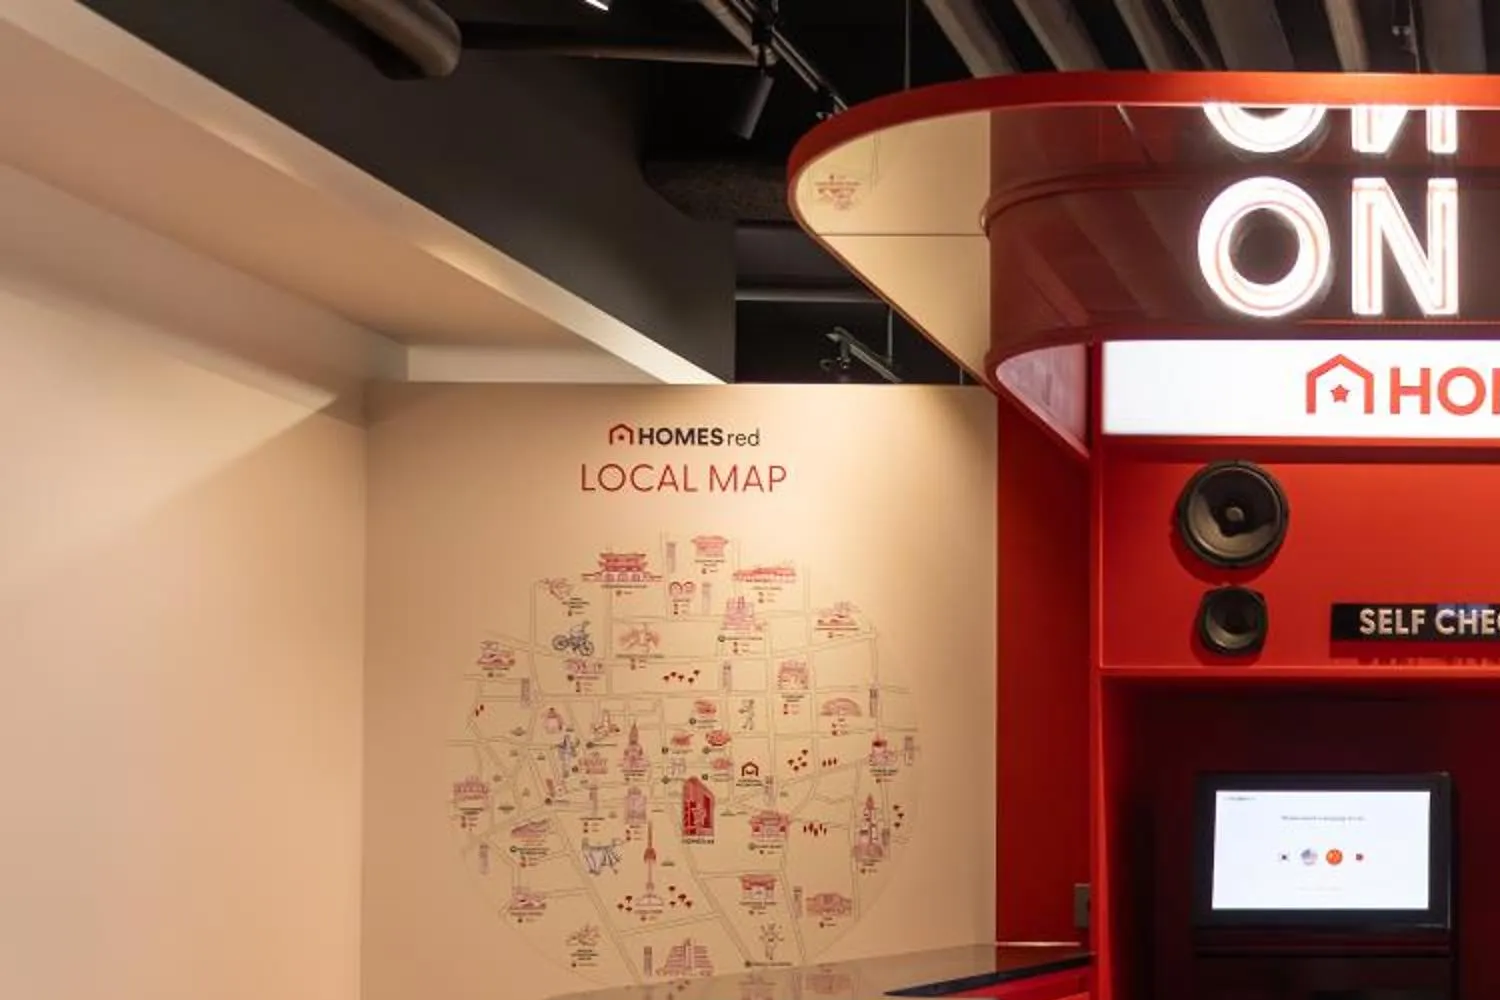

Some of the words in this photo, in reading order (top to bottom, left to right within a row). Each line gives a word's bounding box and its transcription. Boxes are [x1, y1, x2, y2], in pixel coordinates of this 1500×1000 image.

[1198, 176, 1458, 316] ON
[638, 427, 724, 446] HOMES
[726, 428, 761, 447] red
[581, 463, 698, 492] LOCAL
[708, 464, 787, 493] MAP
[1359, 608, 1426, 635] SELF
